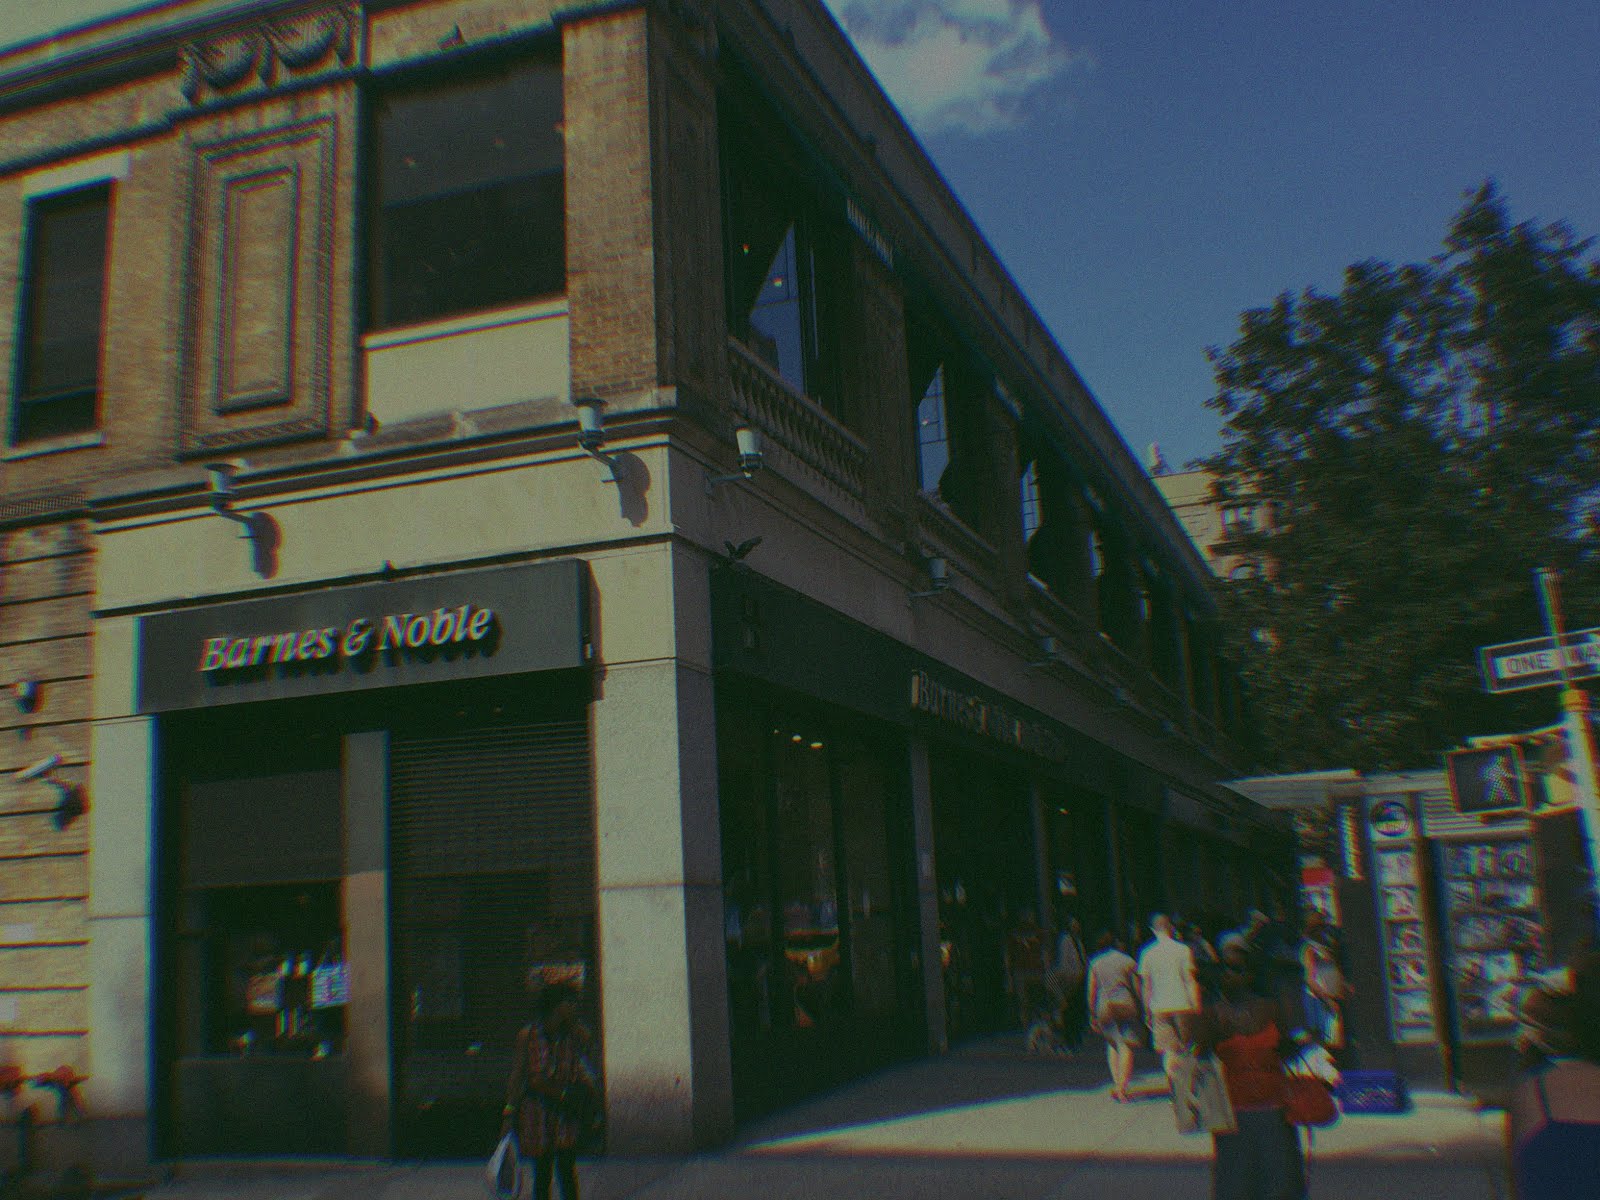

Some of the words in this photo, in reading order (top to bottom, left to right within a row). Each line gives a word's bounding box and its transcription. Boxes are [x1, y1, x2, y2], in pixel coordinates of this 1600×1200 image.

[197, 627, 337, 671] Barnes
[341, 618, 374, 656] &
[375, 604, 494, 651] Noble
[1505, 652, 1550, 674] ONE
[1569, 642, 1600, 664] WA
